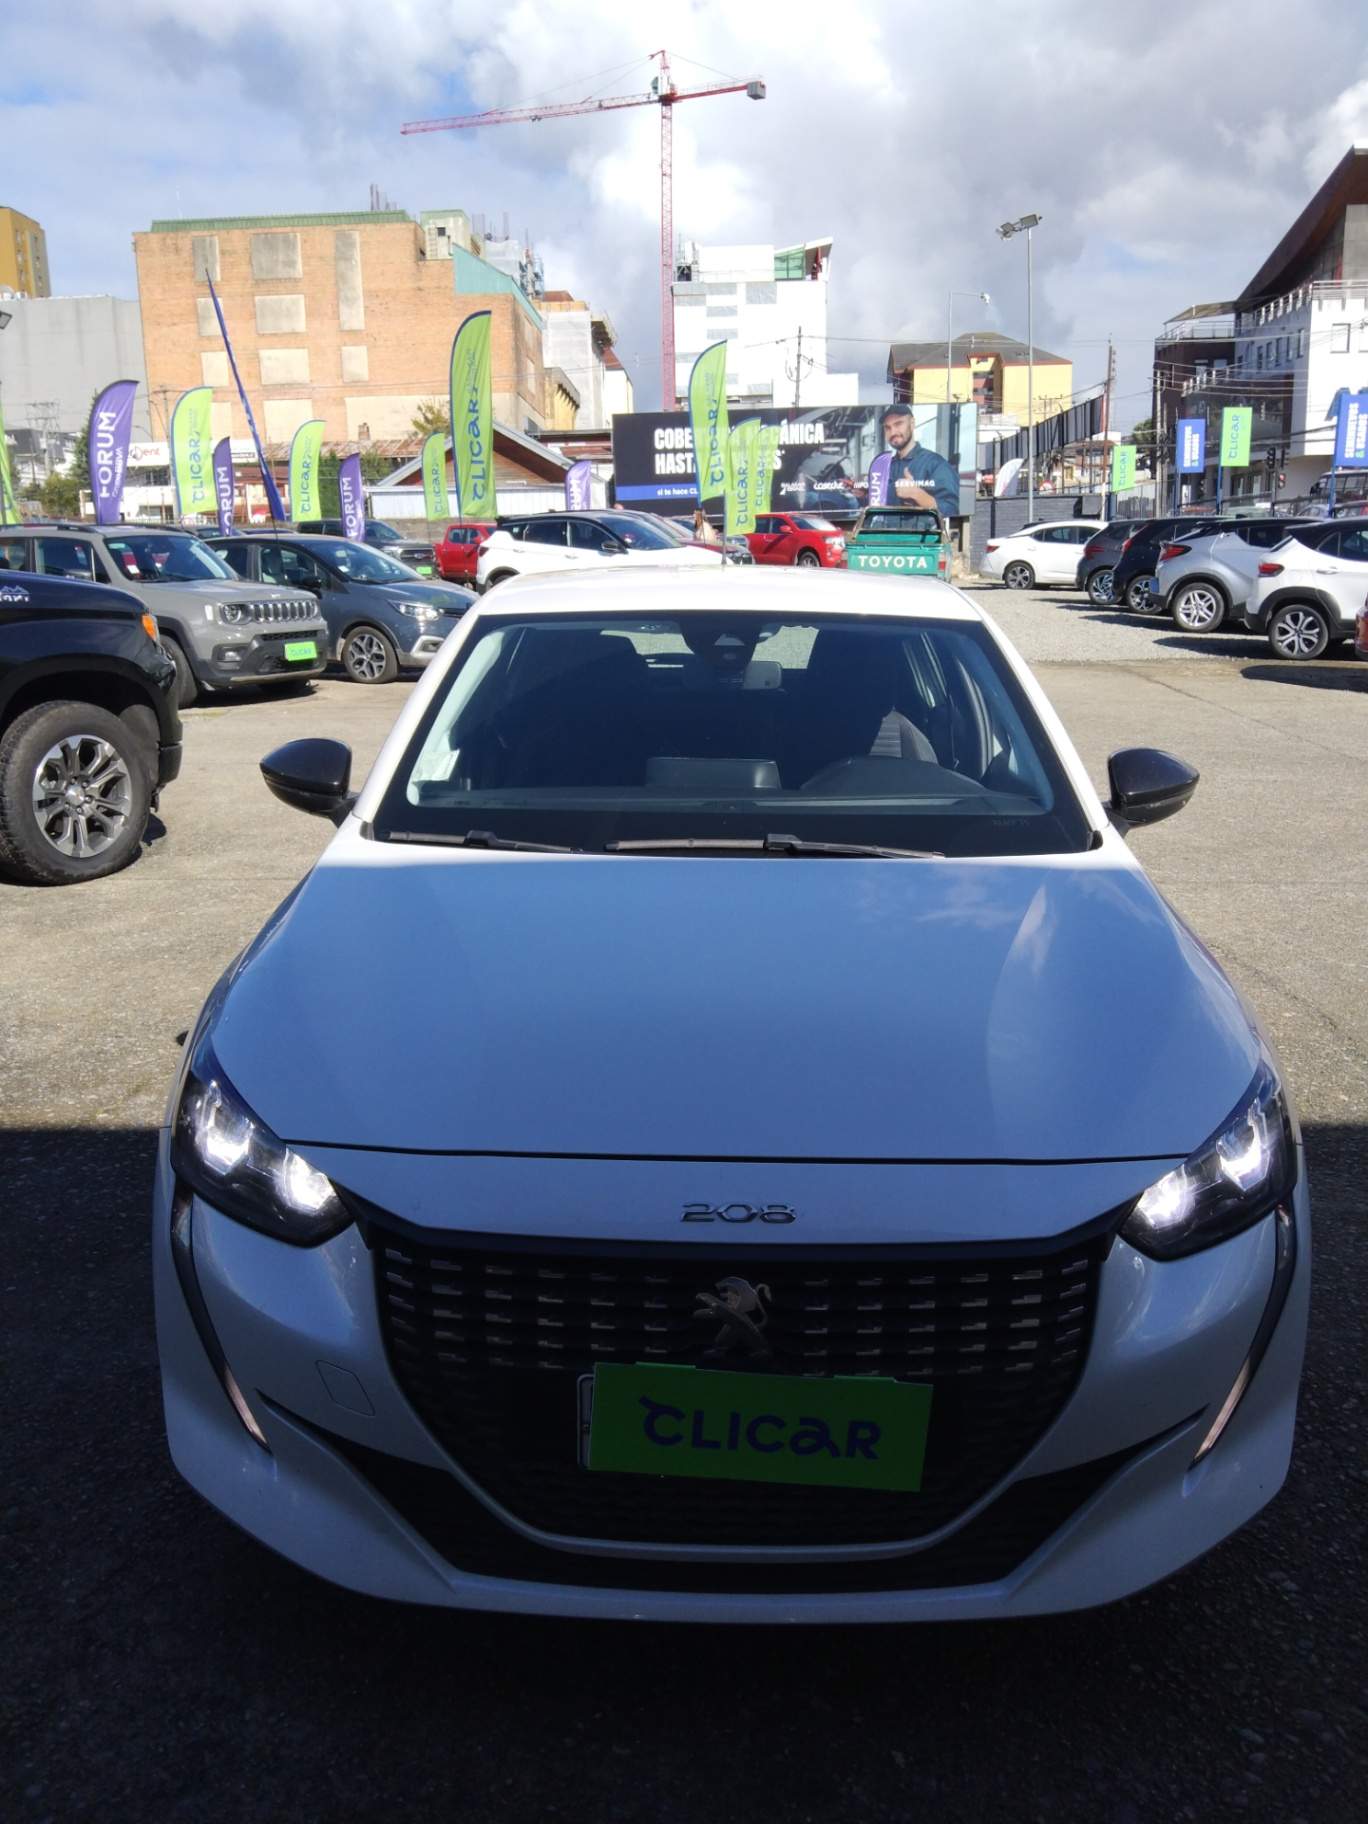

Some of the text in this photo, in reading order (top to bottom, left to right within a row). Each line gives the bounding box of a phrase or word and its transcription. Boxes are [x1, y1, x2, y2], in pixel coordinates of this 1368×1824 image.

[97, 411, 116, 498] FORUM
[342, 476, 359, 537] FORUM
[857, 555, 928, 569] TOYOTA
[680, 1203, 799, 1224] 208
